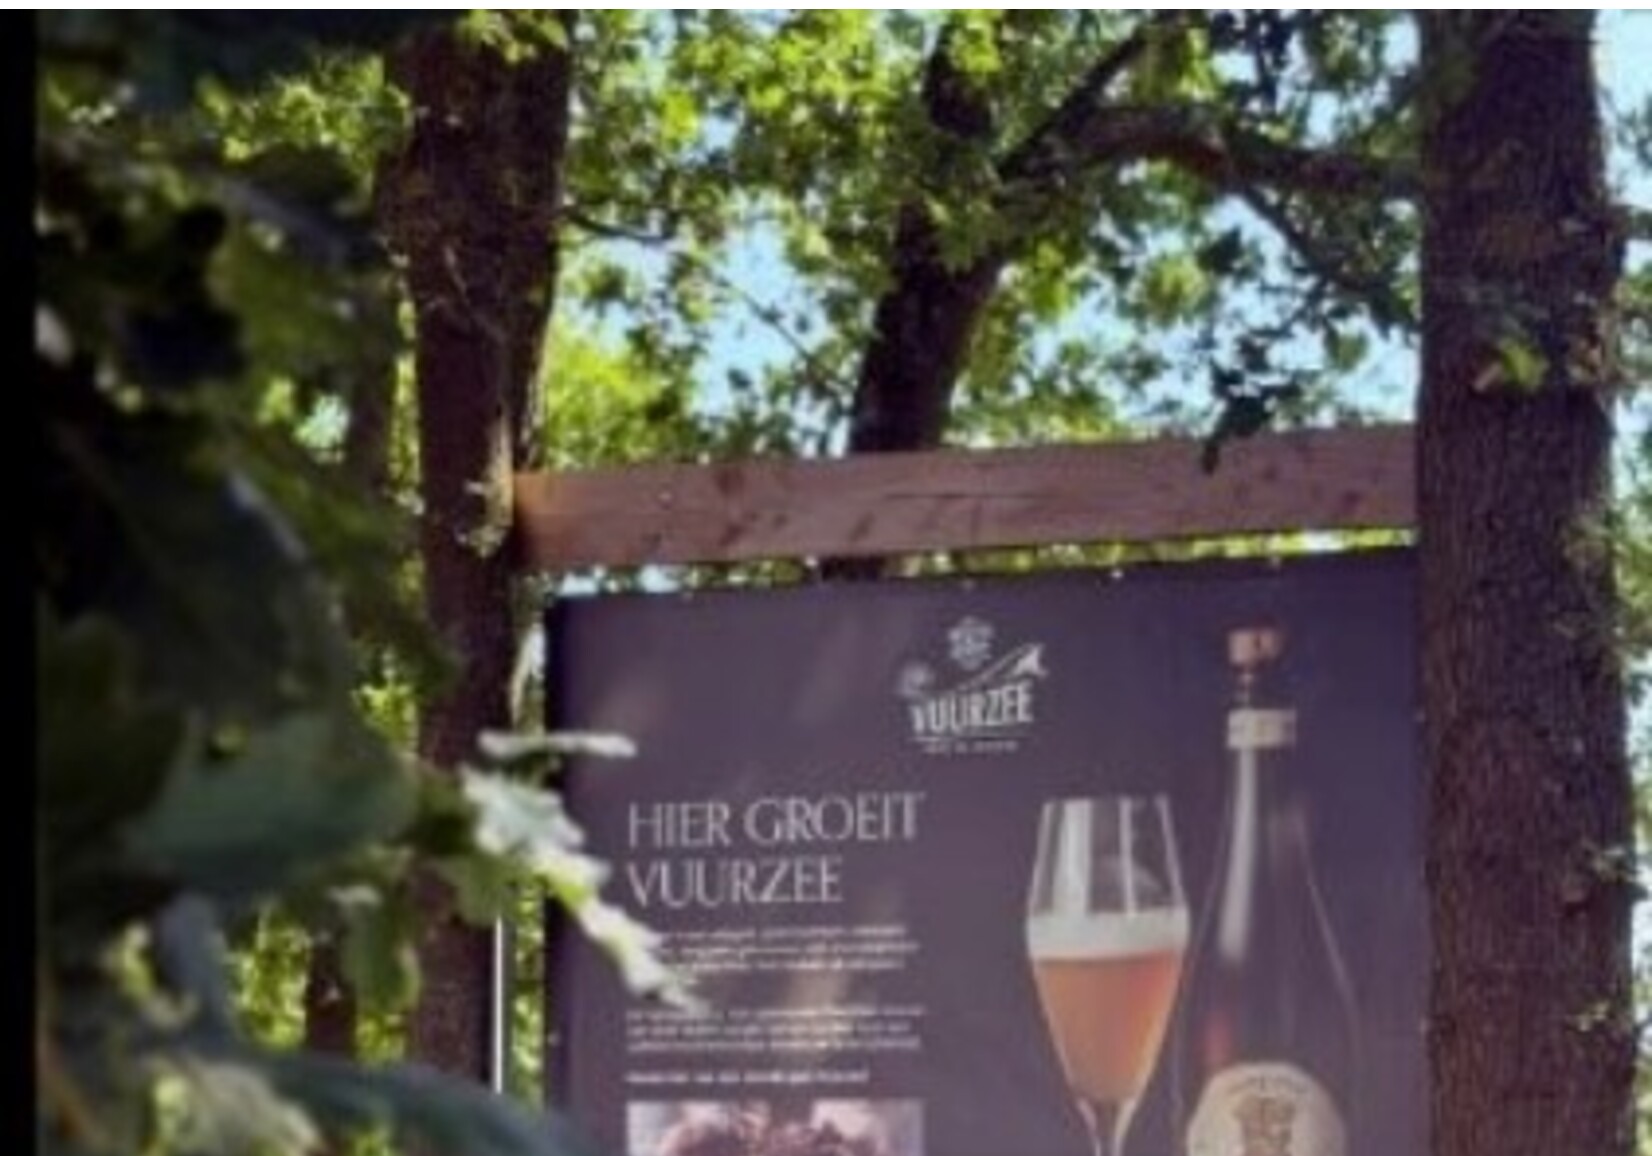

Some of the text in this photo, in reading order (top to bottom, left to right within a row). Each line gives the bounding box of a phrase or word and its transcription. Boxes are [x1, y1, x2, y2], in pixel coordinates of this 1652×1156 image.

[910, 681, 1033, 734] VUURZEE
[627, 792, 925, 848] HIER GROEIT
[627, 856, 843, 907] VUURZEE
